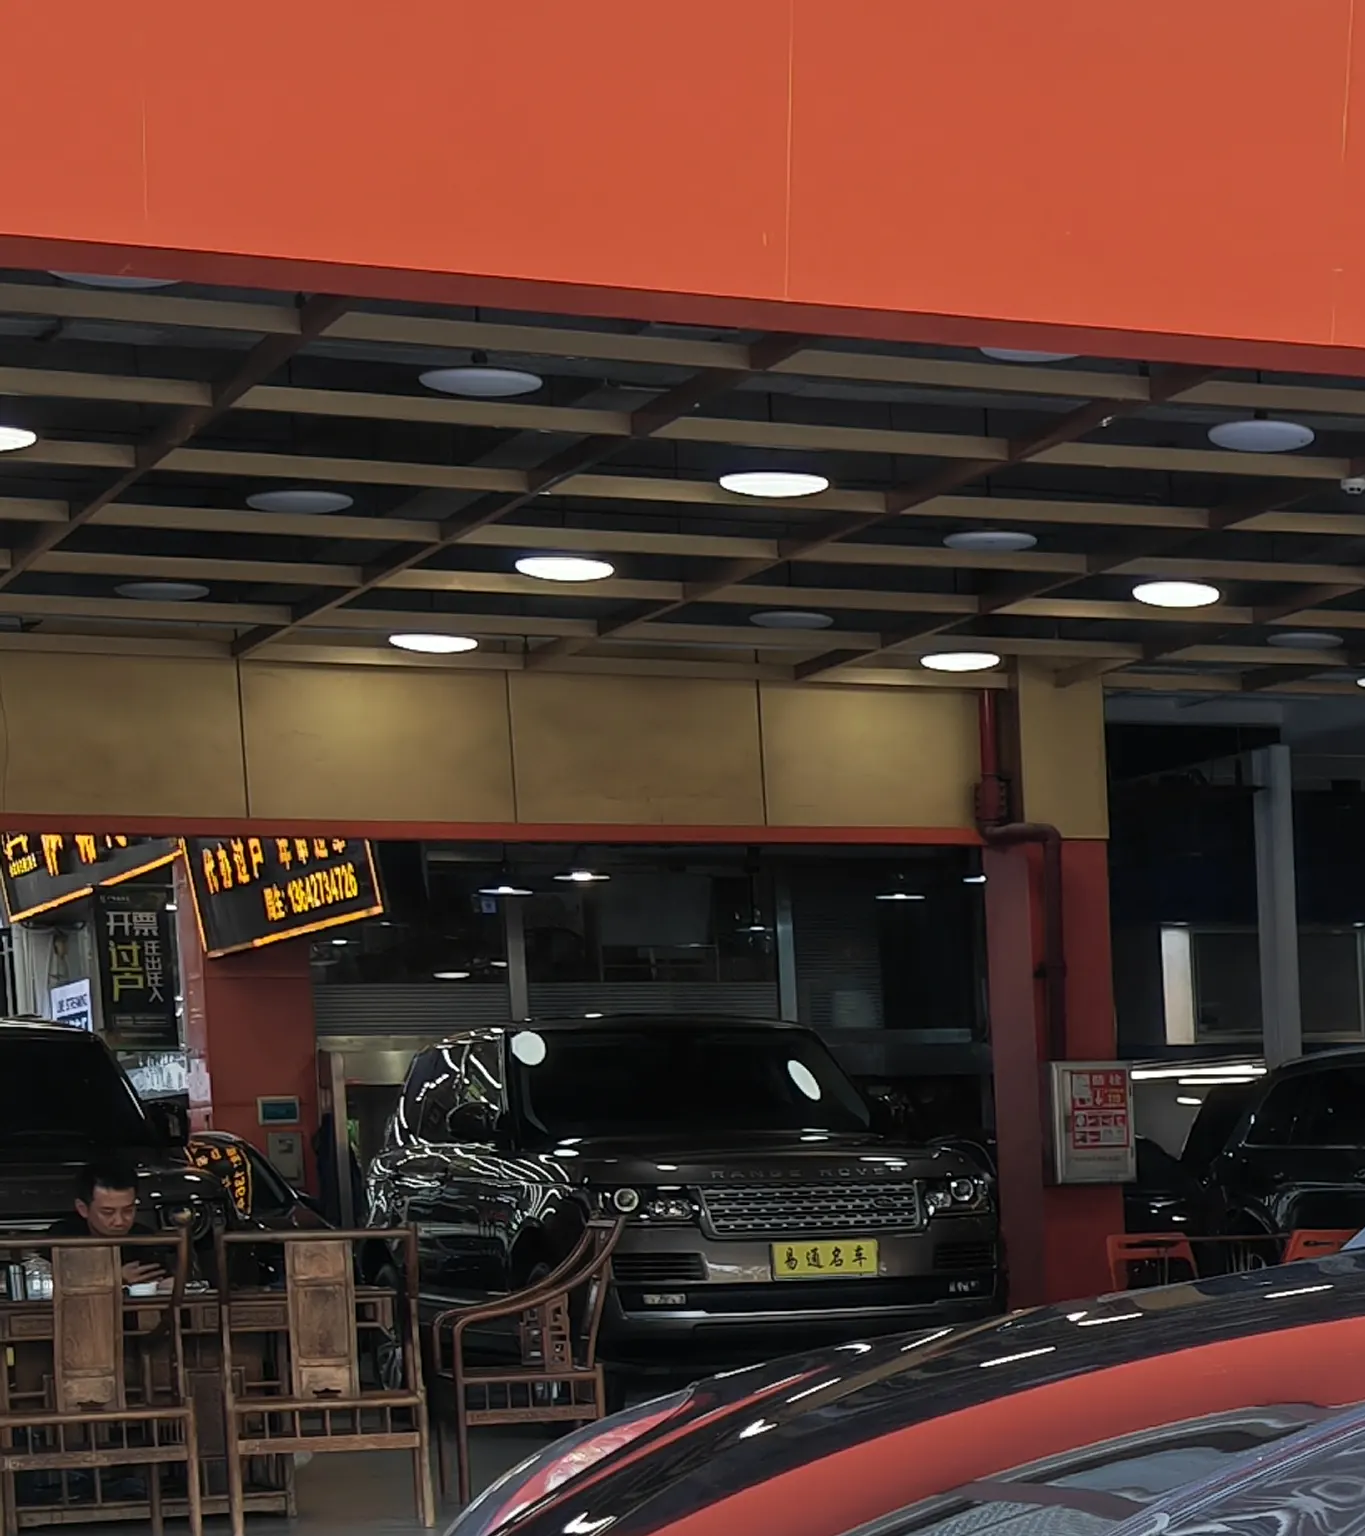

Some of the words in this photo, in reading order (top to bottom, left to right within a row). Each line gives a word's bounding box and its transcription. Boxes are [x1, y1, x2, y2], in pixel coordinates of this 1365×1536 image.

[106, 911, 159, 936] 开票
[109, 940, 144, 1002] 过户
[784, 1245, 868, 1270] 易通名车
